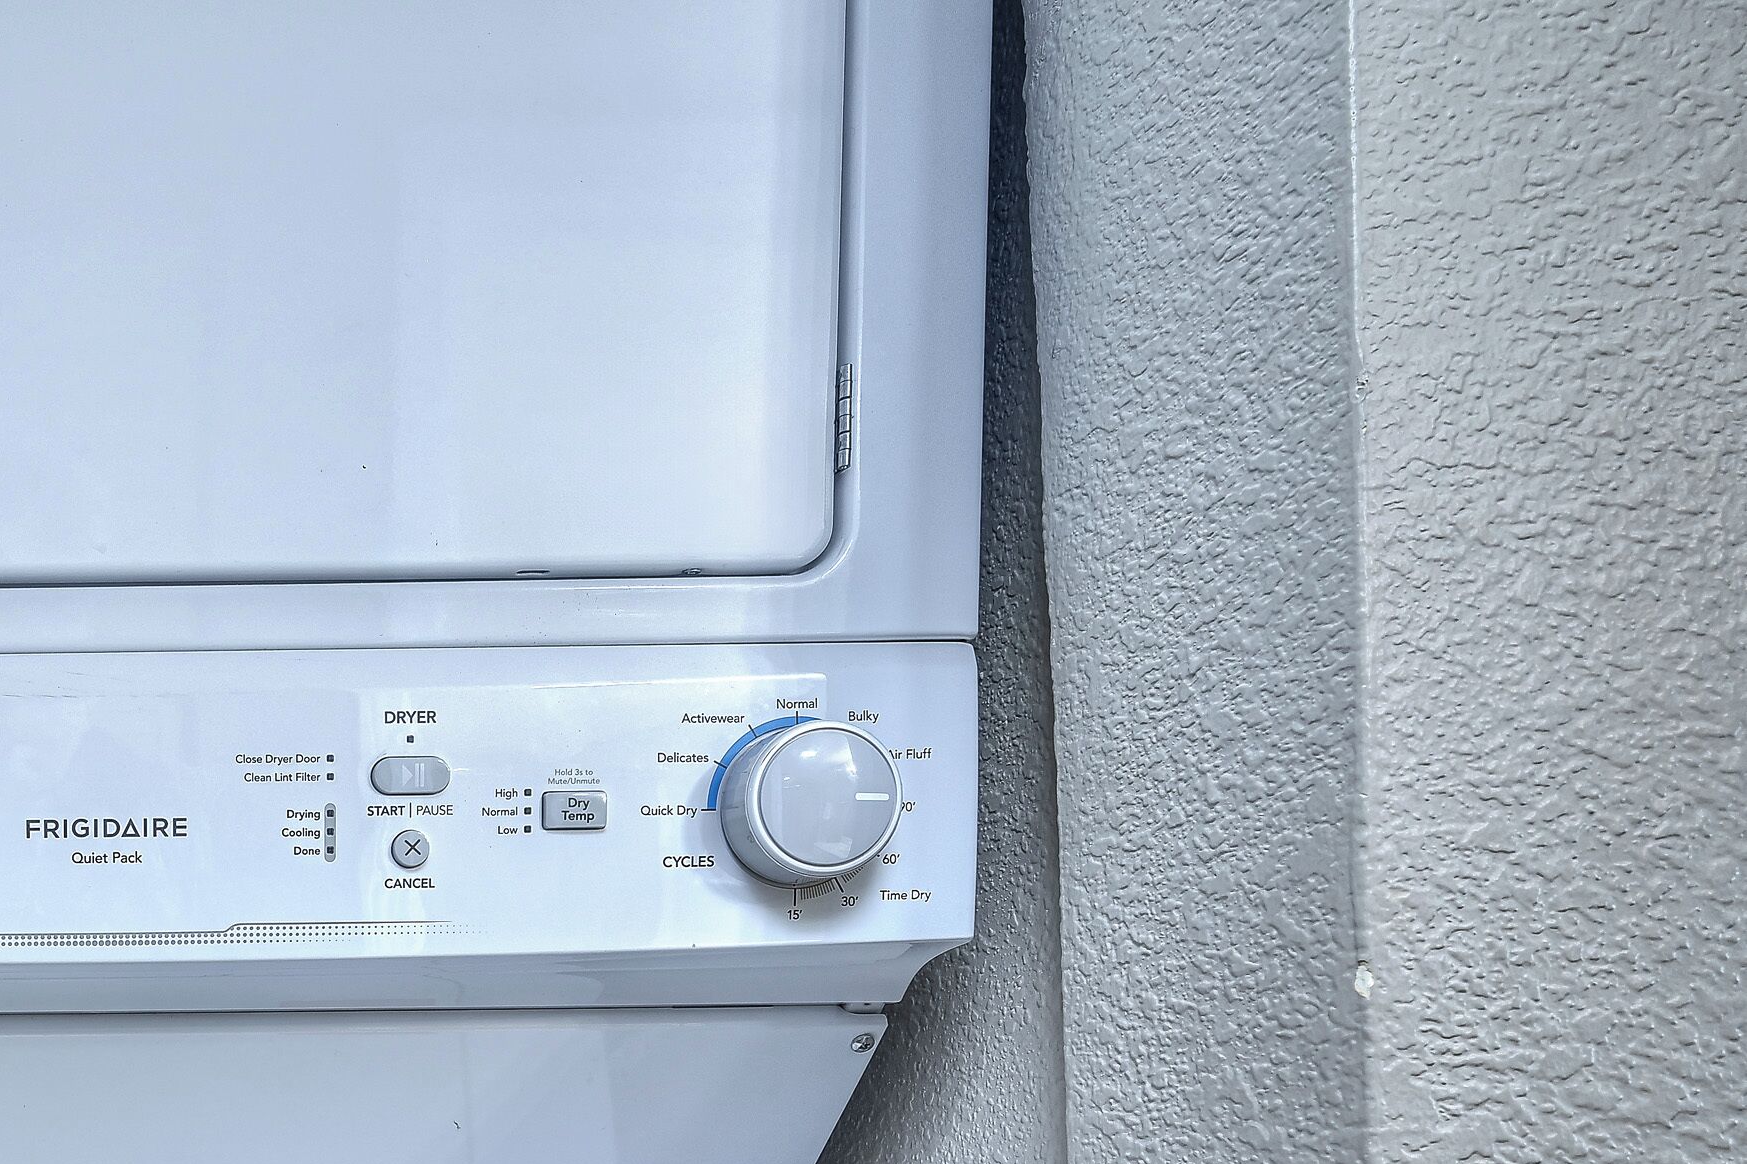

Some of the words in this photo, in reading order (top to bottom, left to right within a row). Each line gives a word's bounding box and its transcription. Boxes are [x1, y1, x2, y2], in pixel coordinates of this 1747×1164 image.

[776, 698, 818, 710] Normal
[384, 711, 437, 724] DRYER
[681, 713, 745, 725] Activewear
[847, 710, 879, 724] Bulky
[235, 754, 262, 764] Close
[264, 754, 293, 766] Dryer
[295, 754, 321, 764] Door
[657, 752, 709, 764] Delicates
[905, 748, 932, 760] Fluff
[244, 772, 271, 782] Clean
[274, 772, 293, 782] Lint
[295, 772, 321, 782] Filter
[554, 768, 573, 776] Hold
[575, 768, 583, 776] 3s
[585, 768, 593, 776] to
[547, 777, 600, 786] Mute/Unmute
[495, 788, 518, 800] High
[367, 805, 405, 816] START
[416, 804, 453, 816] PAUSE
[567, 797, 590, 812] Dry
[286, 809, 321, 822] Drying
[482, 806, 518, 817] Normal
[561, 810, 595, 824] Temp
[640, 804, 675, 817] Quick
[678, 805, 698, 818] Dry
[25, 817, 188, 839] FRIGIDAIRE
[281, 827, 321, 840] Cooling
[497, 824, 518, 835] Low
[293, 845, 321, 856] Done
[71, 851, 108, 866] Quiet
[112, 851, 142, 864] Pack
[662, 855, 715, 868] CYCLES
[384, 877, 435, 889] CANCEL
[879, 889, 907, 901] Time
[909, 888, 932, 903] Dry
